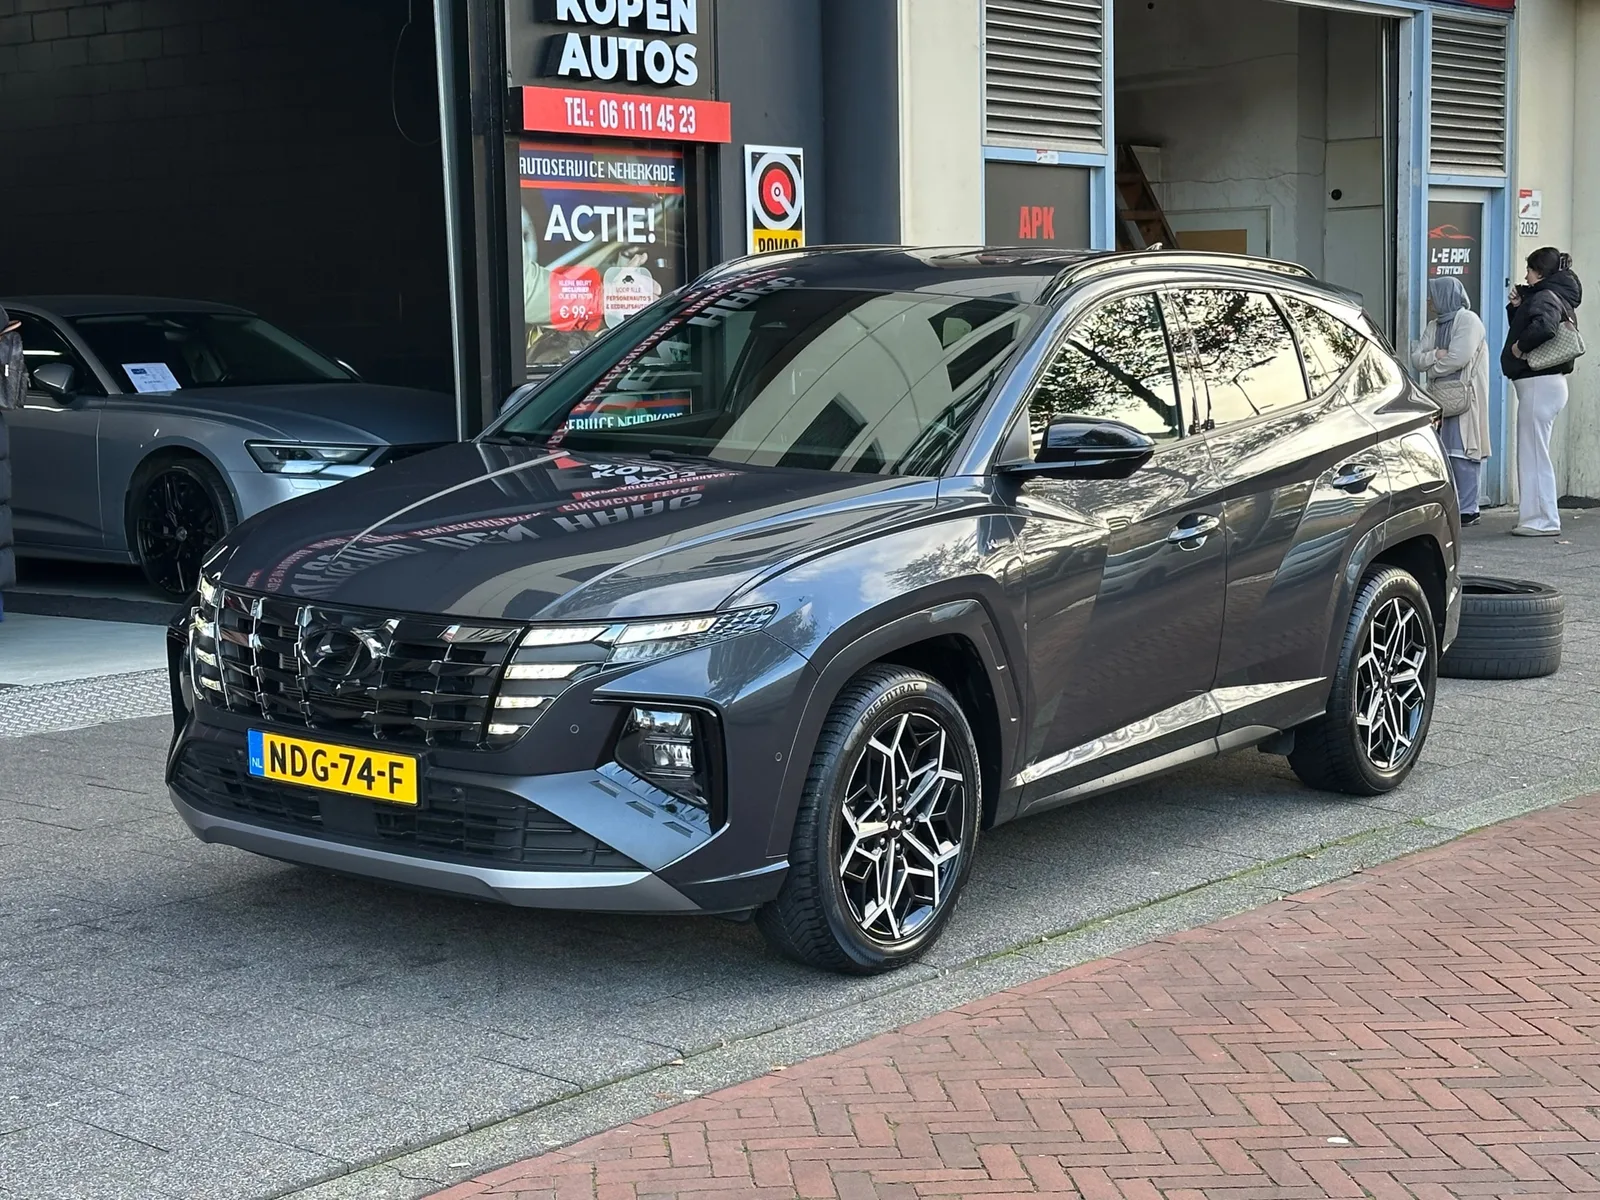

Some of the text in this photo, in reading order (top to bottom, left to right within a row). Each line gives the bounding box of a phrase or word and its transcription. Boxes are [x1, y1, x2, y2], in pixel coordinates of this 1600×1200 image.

[557, 32, 699, 86] AUTOS
[564, 96, 696, 134] TEL: 06 11 11 45 23
[519, 156, 676, 182] AUTOSERVICE NEHERKADE
[543, 204, 657, 245] ACTIE!
[1018, 206, 1055, 240] APK
[1520, 221, 1539, 235] 2032
[1450, 247, 1471, 263] APK
[860, 683, 919, 726] GREENTRAC
[252, 740, 404, 794] NL NDG-74-F
